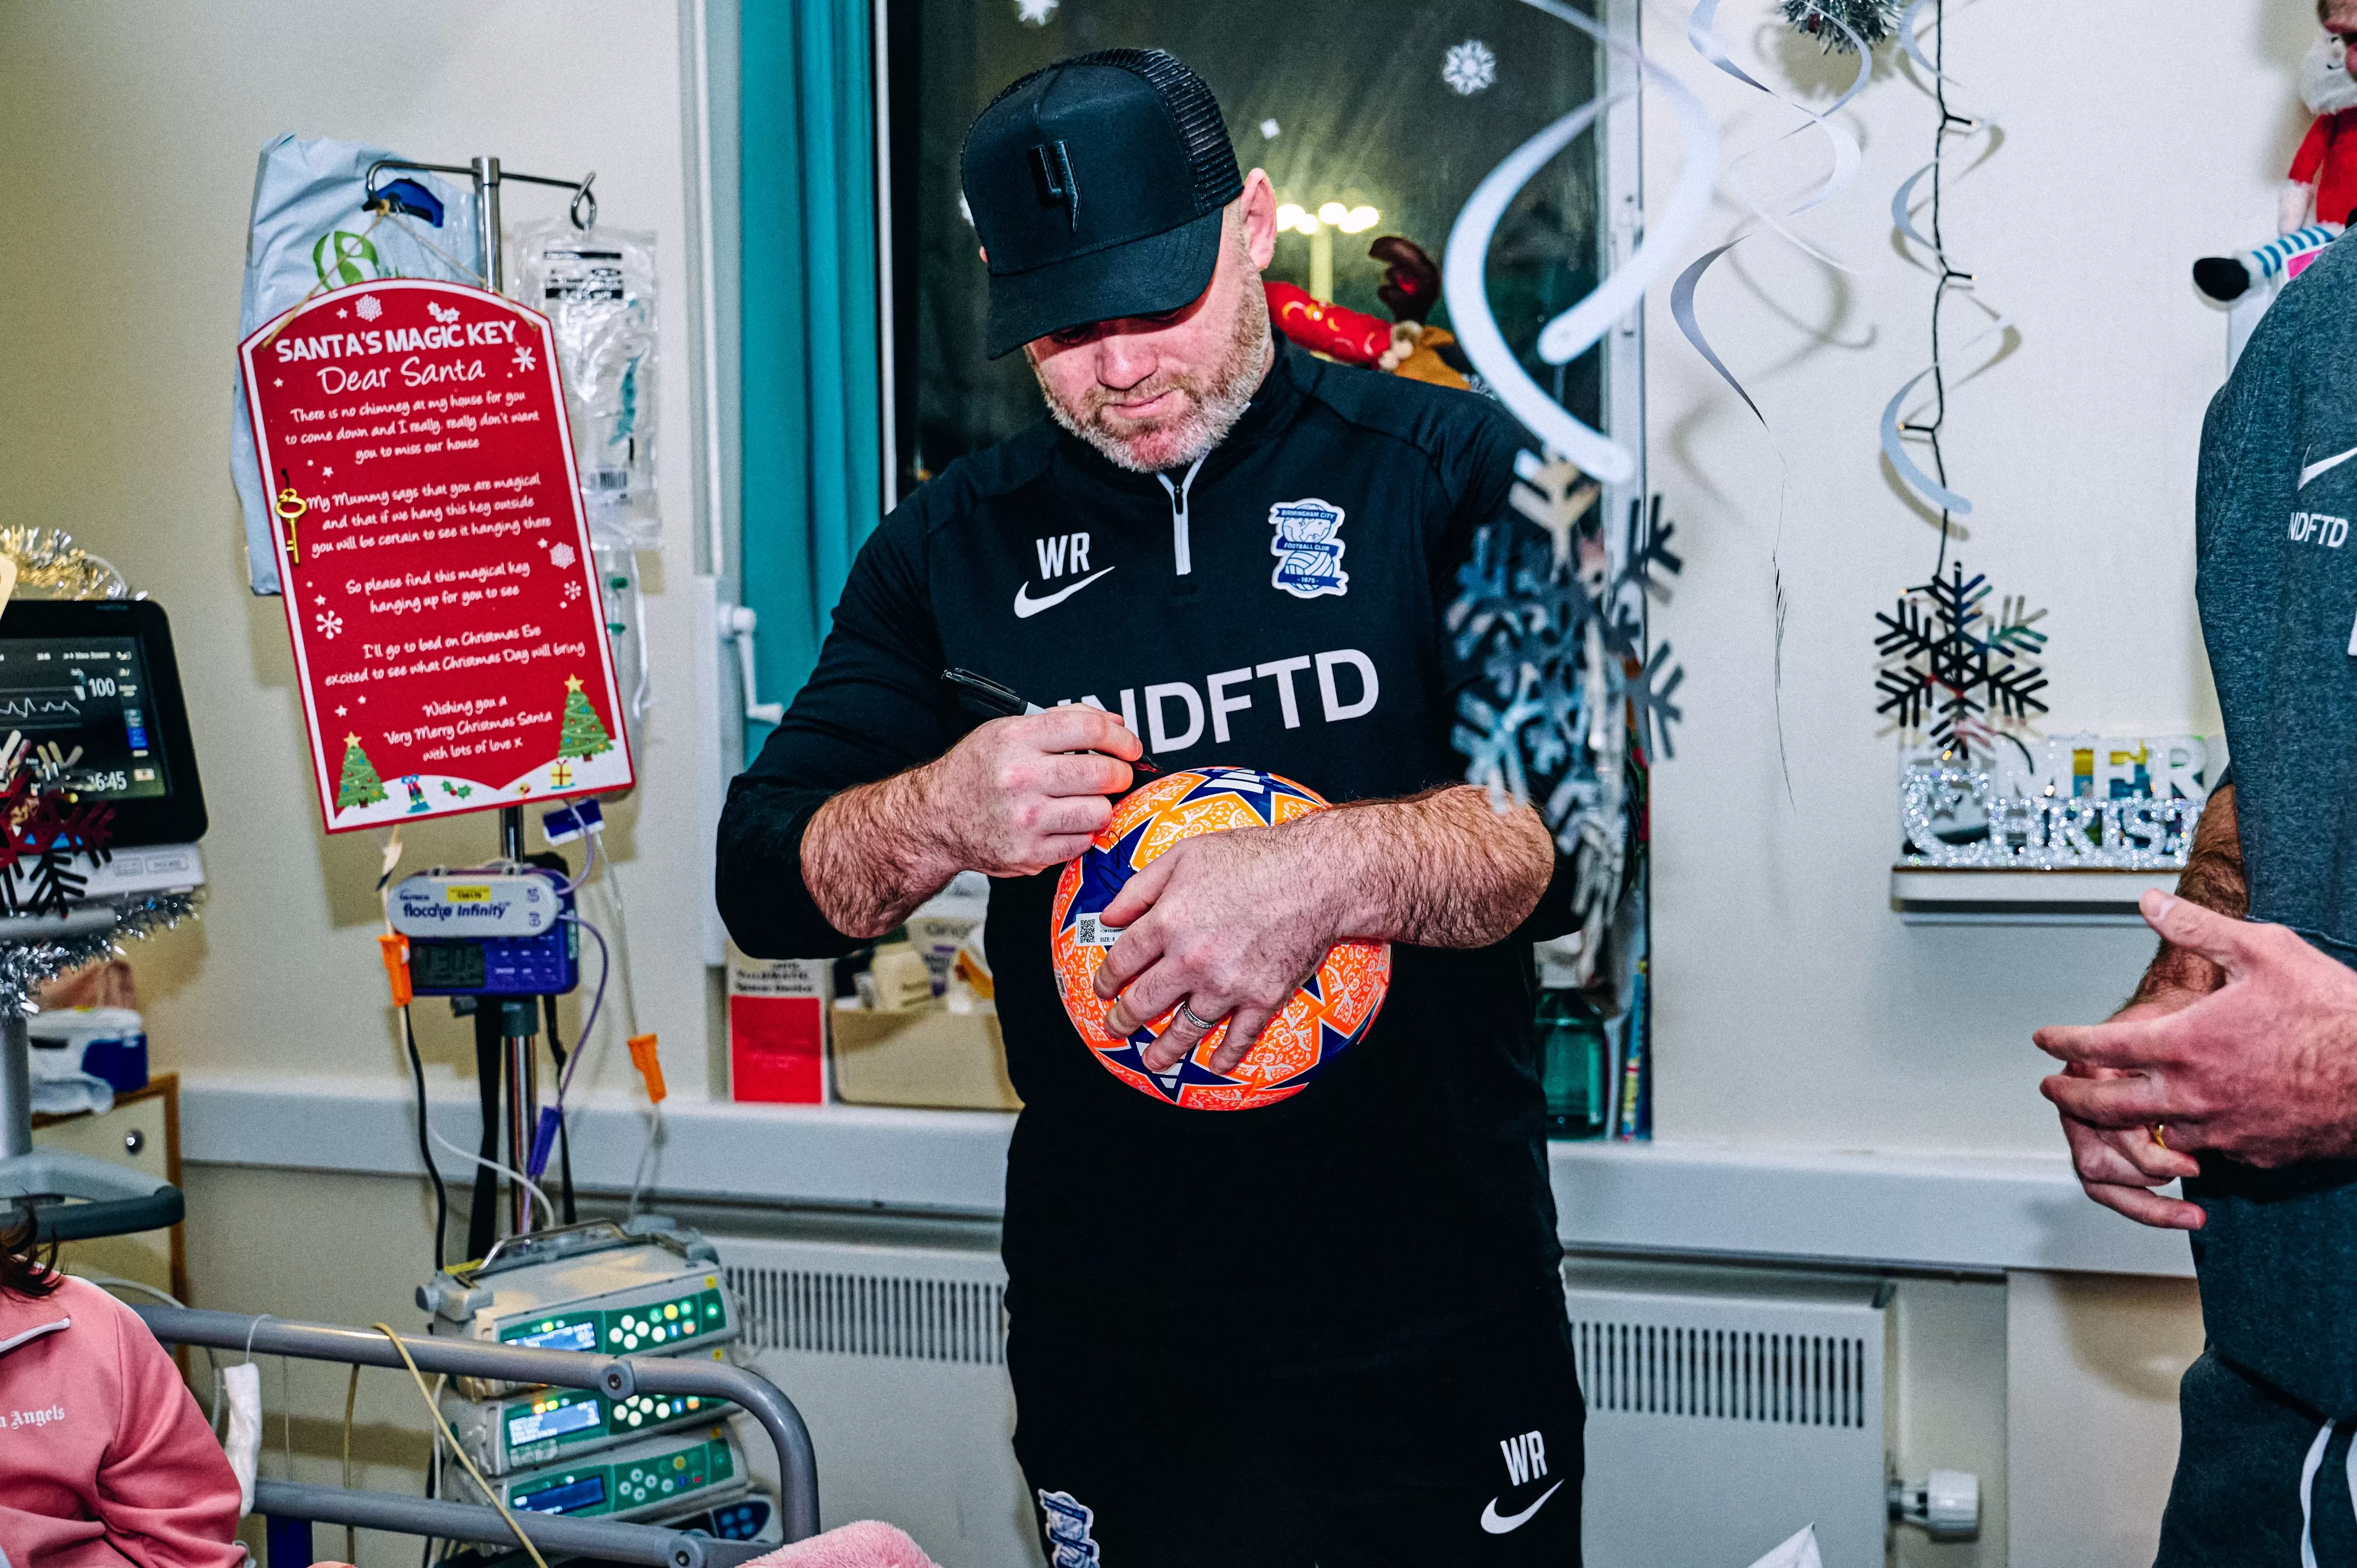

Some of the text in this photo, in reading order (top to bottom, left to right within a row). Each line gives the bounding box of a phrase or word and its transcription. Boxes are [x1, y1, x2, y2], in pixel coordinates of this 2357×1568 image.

[276, 320, 516, 363] SANTA'S MAGIC KEY
[317, 356, 486, 395] Dear Santa
[289, 390, 526, 423] There is no chimney at my house for you
[285, 434, 298, 445] to
[300, 430, 333, 444] come
[336, 426, 369, 441] down
[371, 421, 396, 437] and
[398, 419, 408, 434] I
[445, 414, 477, 432] really
[479, 412, 509, 426] don't
[510, 410, 540, 424] want
[355, 437, 480, 465] you to miss our house
[306, 472, 541, 513] My Mummy says that you are magical
[322, 494, 535, 531] and that if we hang this key outside
[1281, 509, 1335, 519] BIRMINGHAM CITY
[311, 516, 552, 559] you will be certain to see it hanging there
[1036, 532, 1091, 580] WR
[345, 561, 531, 596] So please find this magical key
[369, 585, 520, 616] hanging up for you to see
[362, 623, 541, 661] I'll go to bed on Christmas Eve
[325, 642, 586, 686] excited to see what Christmas Day will bring
[87, 677, 116, 697] 100
[422, 696, 508, 718] Wishing you a
[383, 711, 553, 747] Very Merry Christmas Santa
[422, 737, 523, 762] with lots of love x
[457, 903, 506, 919] Infinity
[11, 1404, 65, 1430] Angels
[1500, 1430, 1548, 1486] WR
